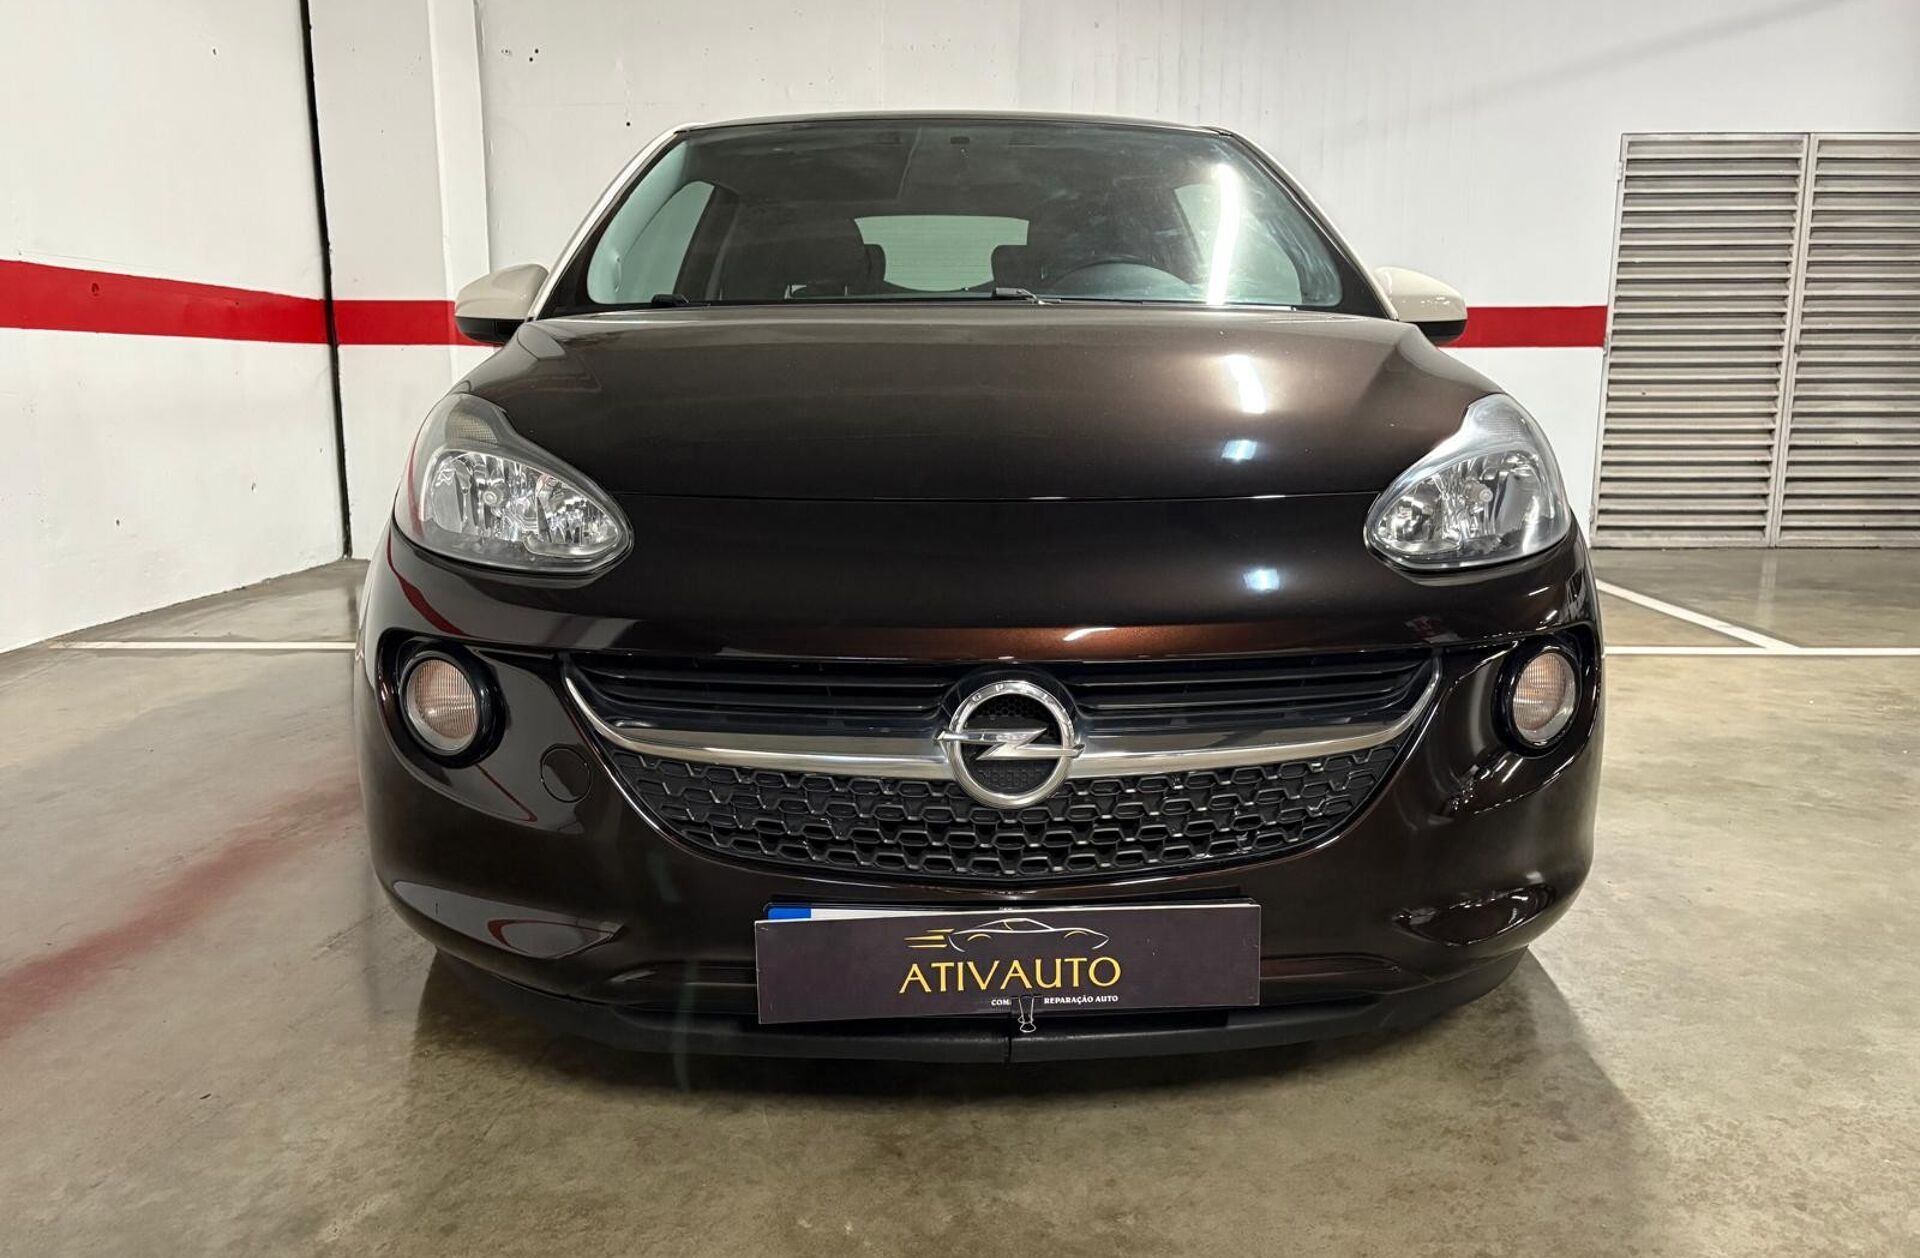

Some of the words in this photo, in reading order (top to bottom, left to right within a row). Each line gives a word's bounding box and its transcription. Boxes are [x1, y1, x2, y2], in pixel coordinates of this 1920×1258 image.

[899, 956, 1122, 994] ATIVAUTO
[1043, 994, 1094, 1005] REPARAÇÃO
[1095, 995, 1119, 1003] AUTO
